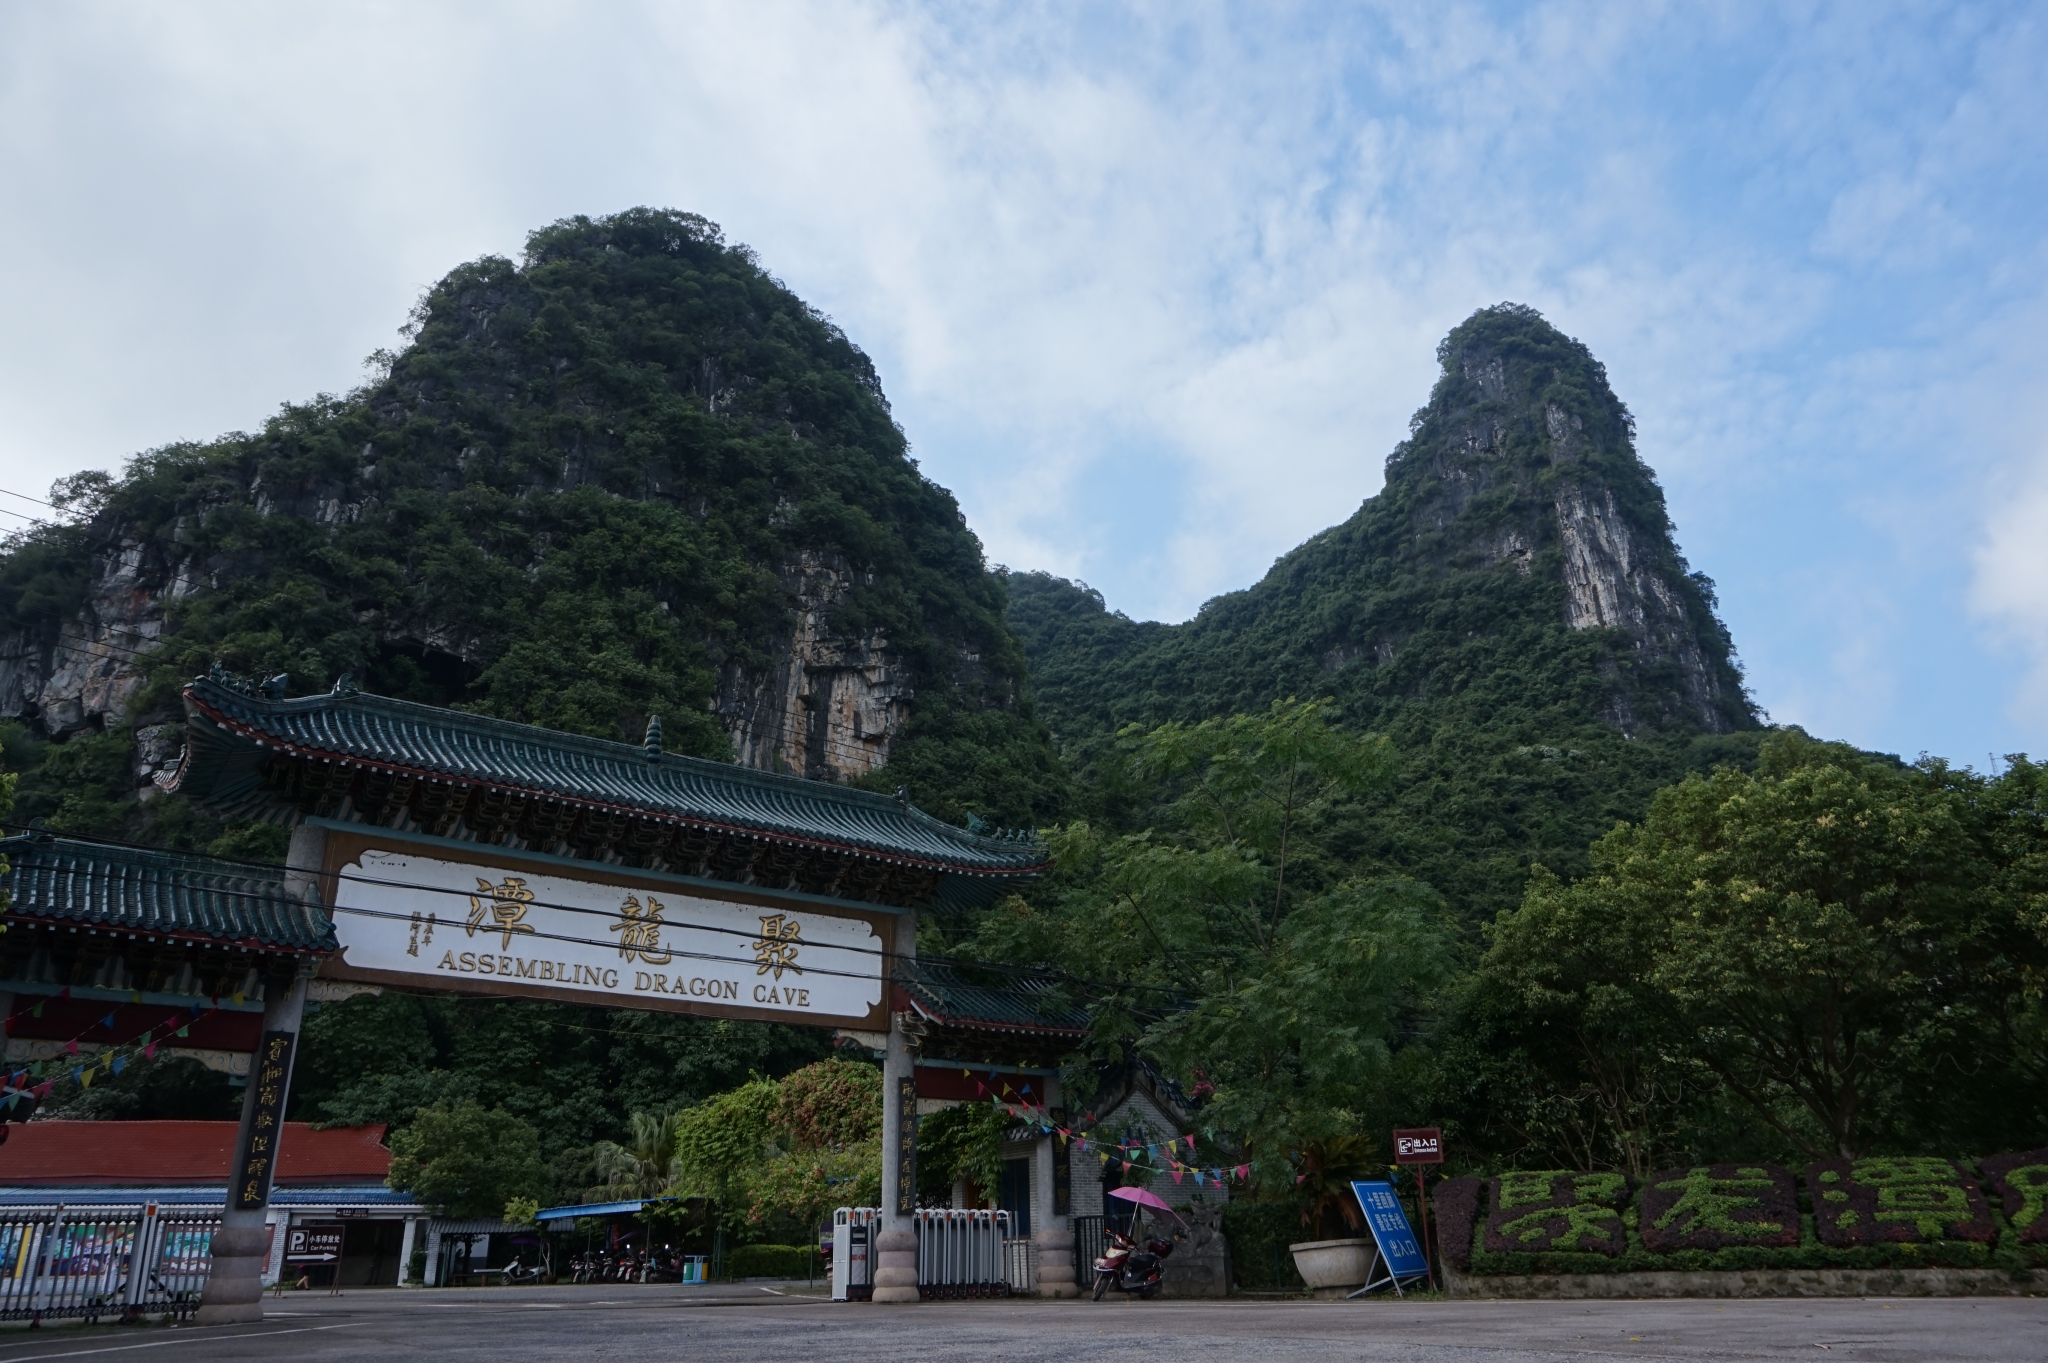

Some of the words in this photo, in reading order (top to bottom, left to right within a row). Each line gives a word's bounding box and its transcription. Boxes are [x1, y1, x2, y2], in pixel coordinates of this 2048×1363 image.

[438, 949, 618, 989] ASSEMBLING
[635, 971, 740, 1000] DRAGON
[753, 983, 811, 1008] CAVE
[1413, 1138, 1437, 1147] 出入口
[308, 1234, 340, 1244] 小车停放处
[1388, 1239, 1416, 1258] 出入口
